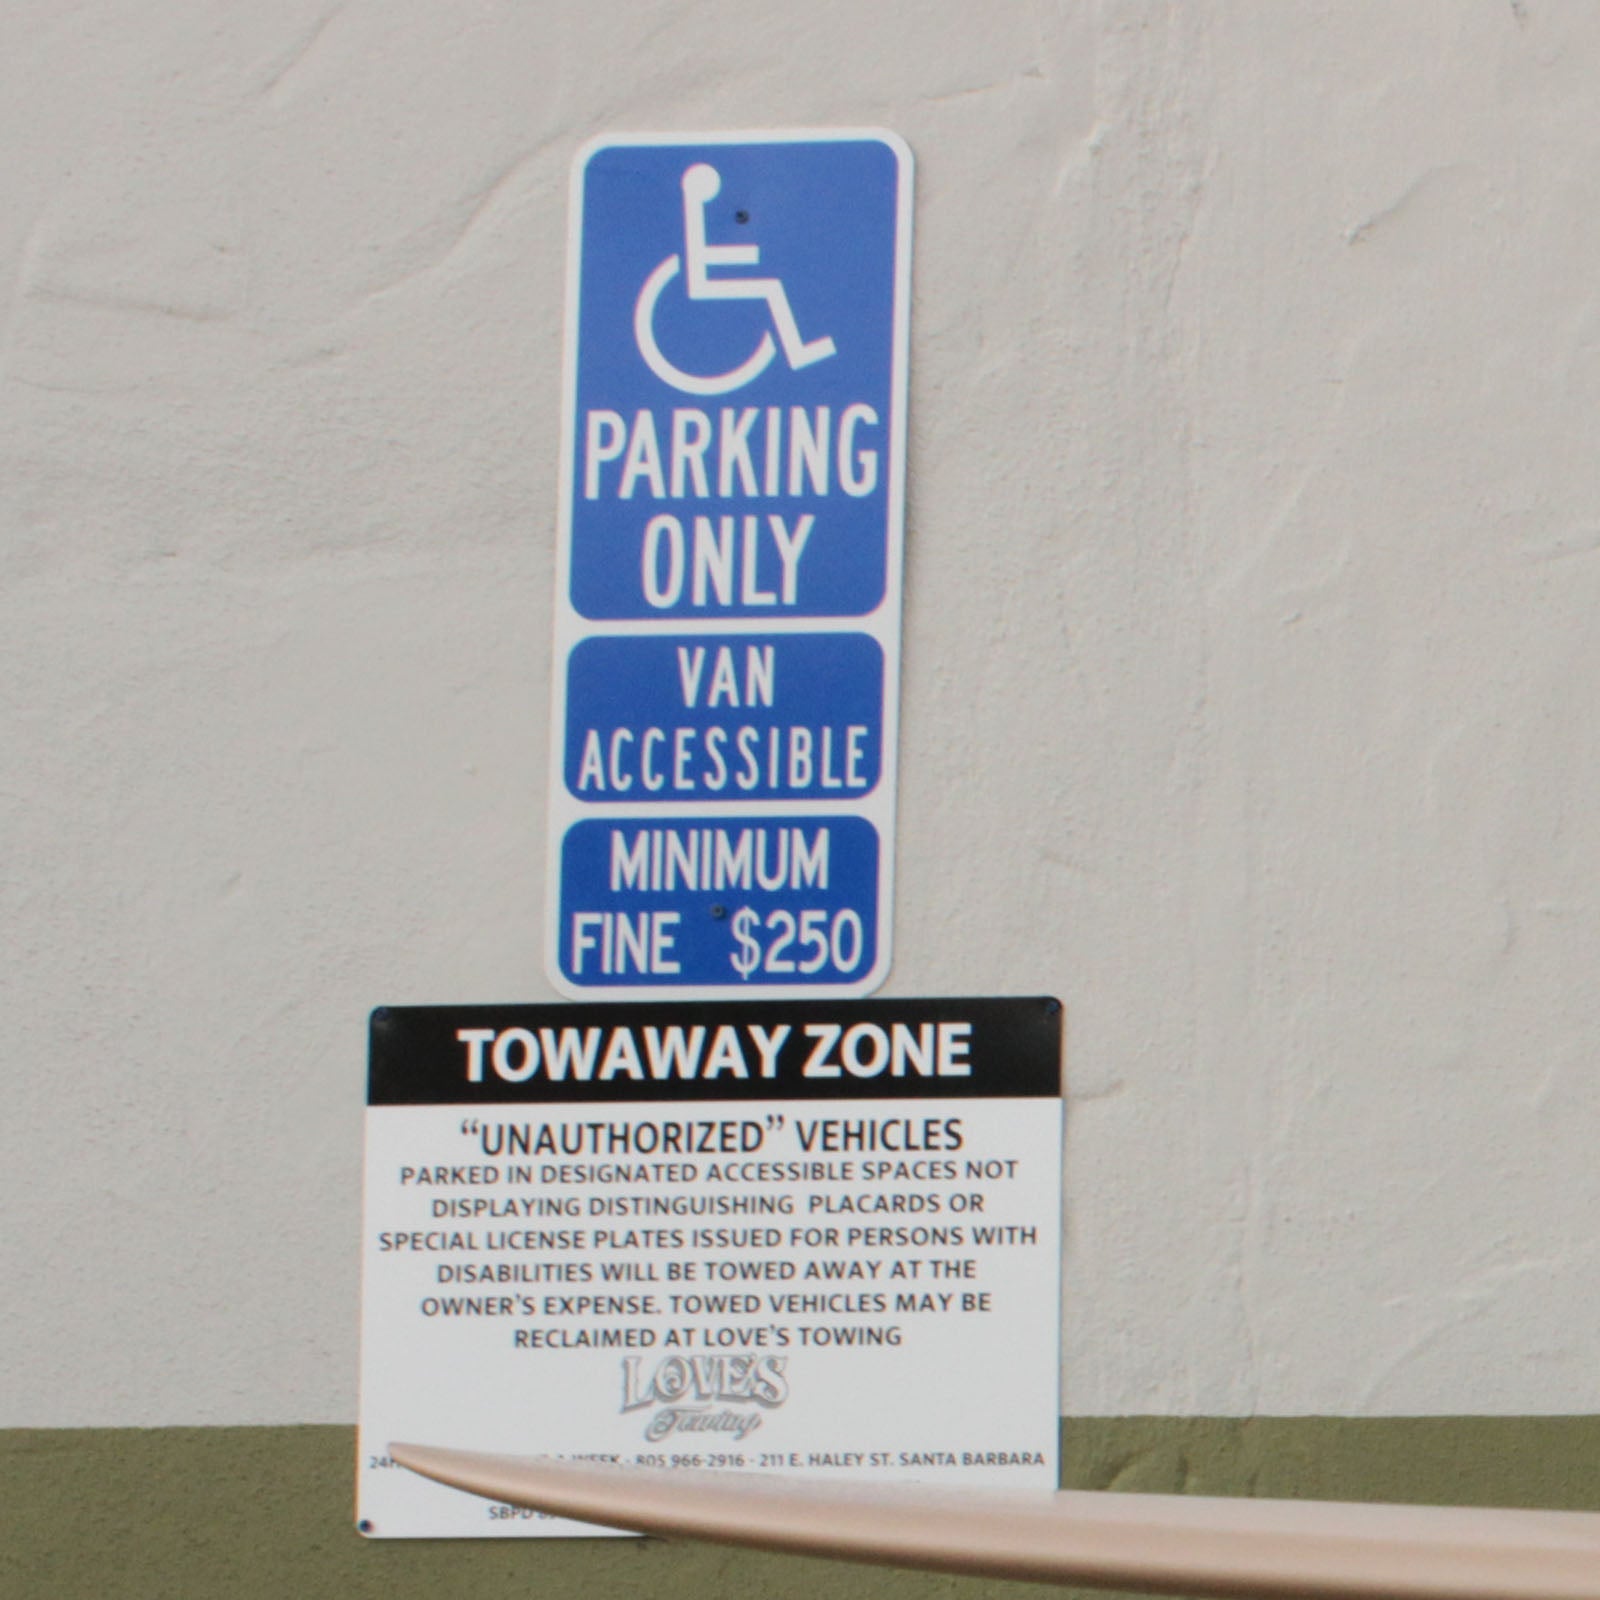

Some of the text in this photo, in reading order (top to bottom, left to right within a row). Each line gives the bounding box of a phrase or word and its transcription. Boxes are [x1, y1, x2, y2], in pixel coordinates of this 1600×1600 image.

[585, 403, 878, 500] PARKING
[642, 514, 815, 609] ONLY
[677, 645, 775, 708] VAN
[578, 725, 868, 792] ACCESSIBLE
[610, 827, 830, 892] MINIMUM
[572, 906, 863, 981] FINE $250
[457, 1022, 972, 1083] TOWAWAY ZONE
[461, 1114, 963, 1156] “UNAUTHORIZED” VEHICLES
[400, 1160, 1018, 1185] PARKED IN DESIGNATED ACCESSIBLE SPACES NOT
[432, 1193, 984, 1218] DISPLAYING DISTINGUISHING PLACARDS OR
[379, 1226, 1037, 1252] SPECIAL LICENSE PLATES ISSUED FOR PERSONS WITH
[437, 1259, 976, 1284] DISABILITIES WILL BE TOWED AWAY AT THE
[421, 1292, 990, 1317] OWNER'S EXPENSE. TOWED VEHICLES MAY BE
[514, 1324, 902, 1349] RECLAIMED AT LOVE'S TOWING
[620, 1353, 789, 1413] LOVE'S
[671, 1453, 744, 1468] 966-2916
[760, 1454, 784, 1467] 211
[809, 1453, 864, 1466] HALEY
[870, 1453, 893, 1466] ST.
[899, 1452, 956, 1466] SANTA
[963, 1452, 1044, 1466] BARBARA
